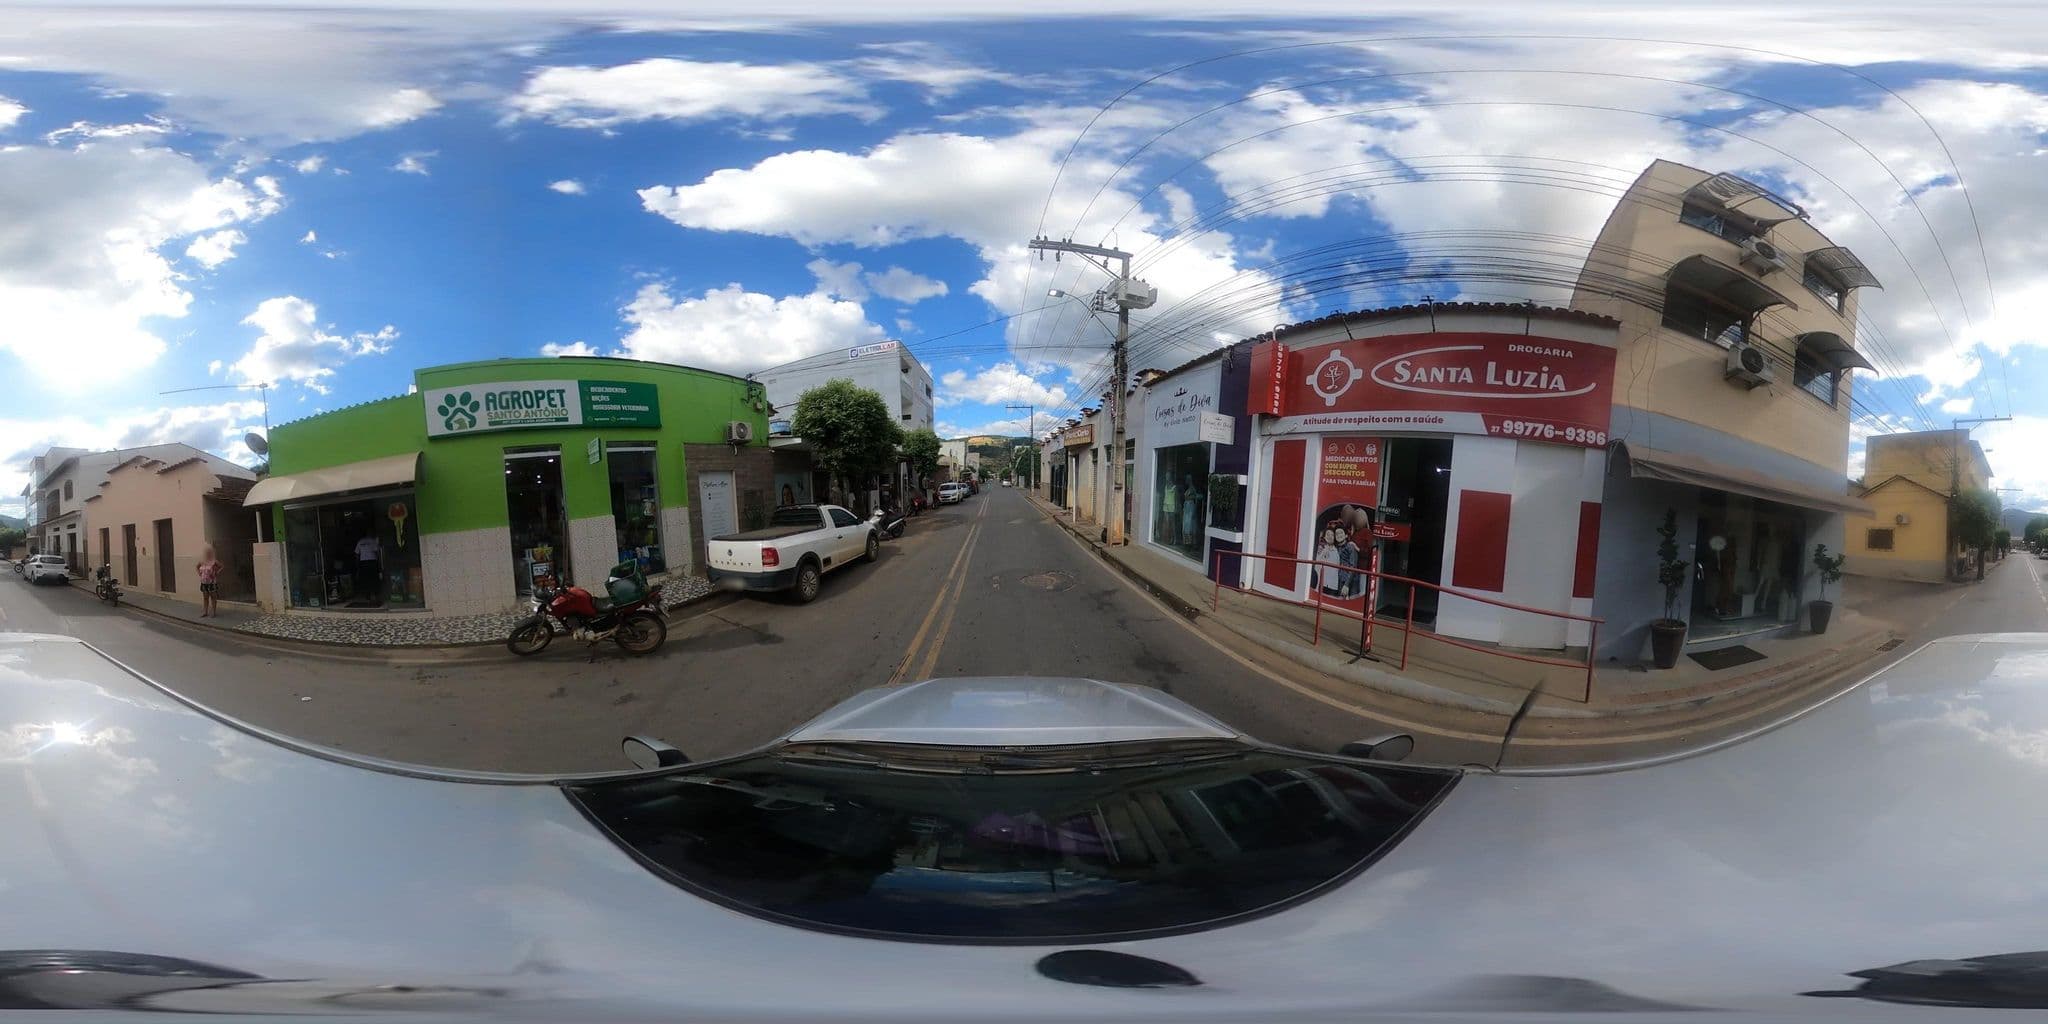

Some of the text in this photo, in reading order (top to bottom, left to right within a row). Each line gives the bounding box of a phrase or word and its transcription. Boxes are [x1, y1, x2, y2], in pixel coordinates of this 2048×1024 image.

[1508, 344, 1574, 358] DROGARIA
[1393, 360, 1474, 383] SANTA
[485, 389, 566, 411] AGROPET
[487, 407, 569, 420] SANTO ANTÔNIO
[1303, 416, 1331, 425] Atitude
[1333, 416, 1343, 425] de
[1344, 415, 1380, 426] respeito
[1413, 414, 1444, 424] saúde
[1503, 420, 1606, 446] 99776-9396
